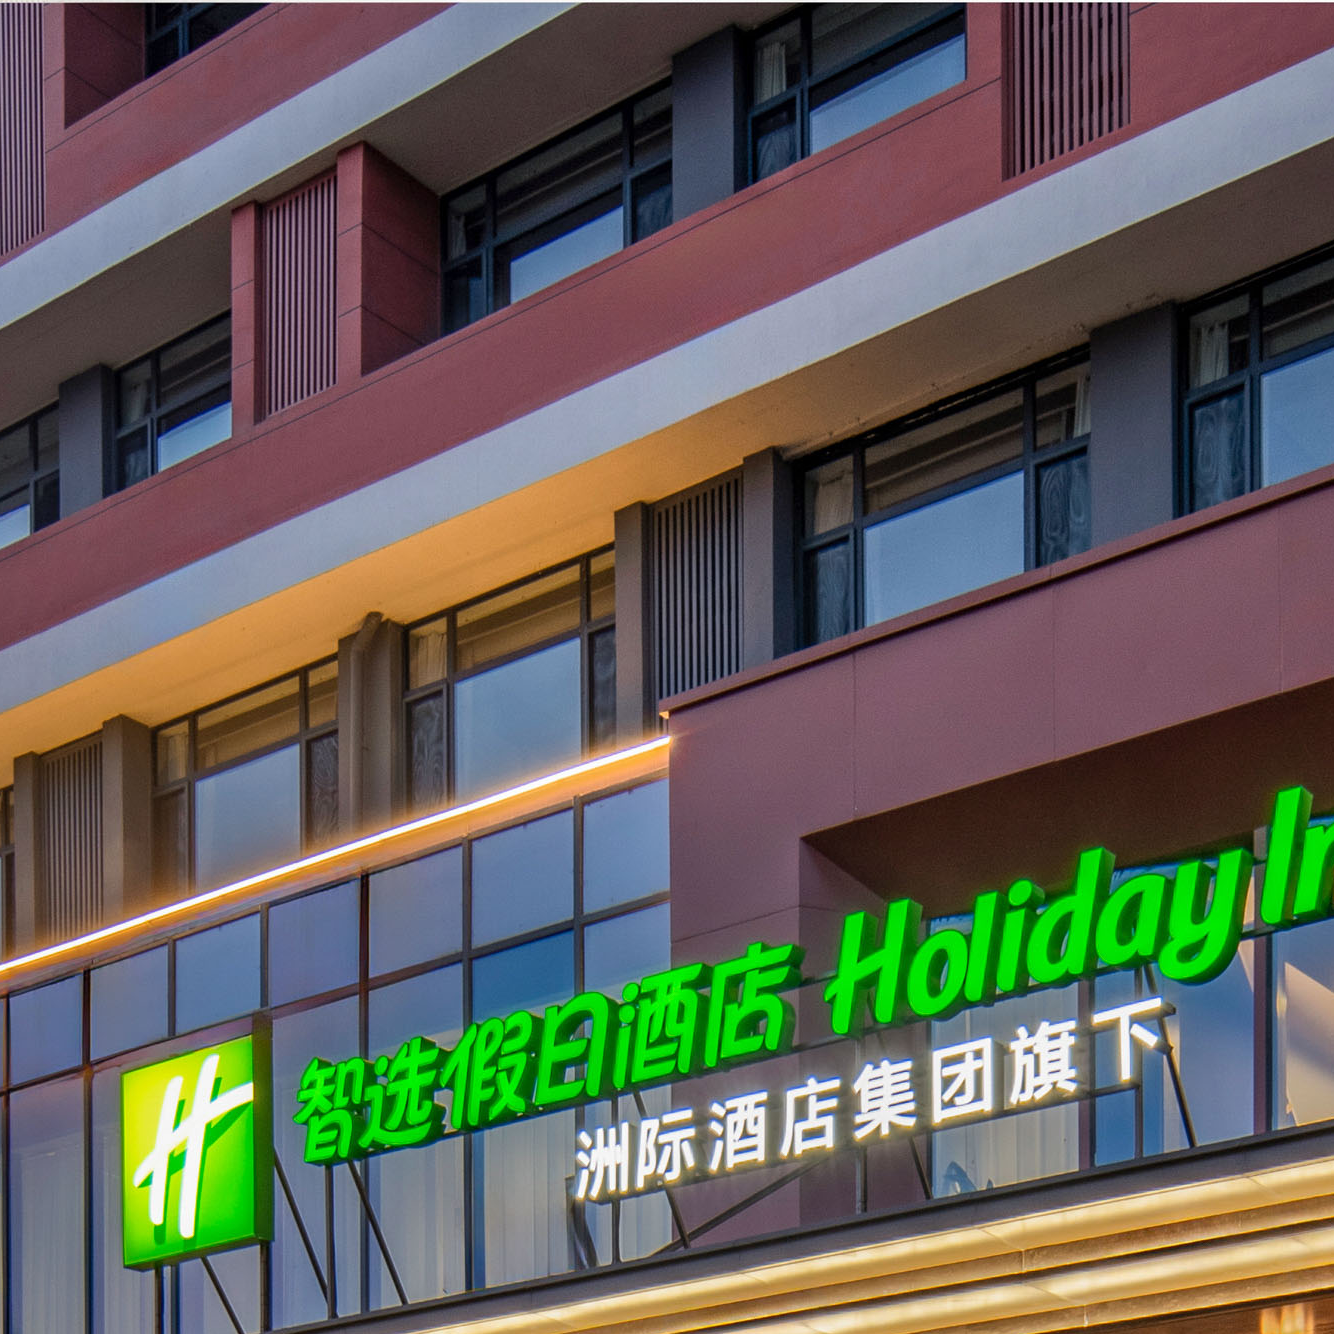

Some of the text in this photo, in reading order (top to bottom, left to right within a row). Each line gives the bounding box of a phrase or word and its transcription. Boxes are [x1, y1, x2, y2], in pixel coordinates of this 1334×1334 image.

[292, 942, 797, 1163] 智选假日酒店
[824, 846, 1249, 1036] Holiday
[575, 996, 1166, 1201] 洲际酒店集团旗下
